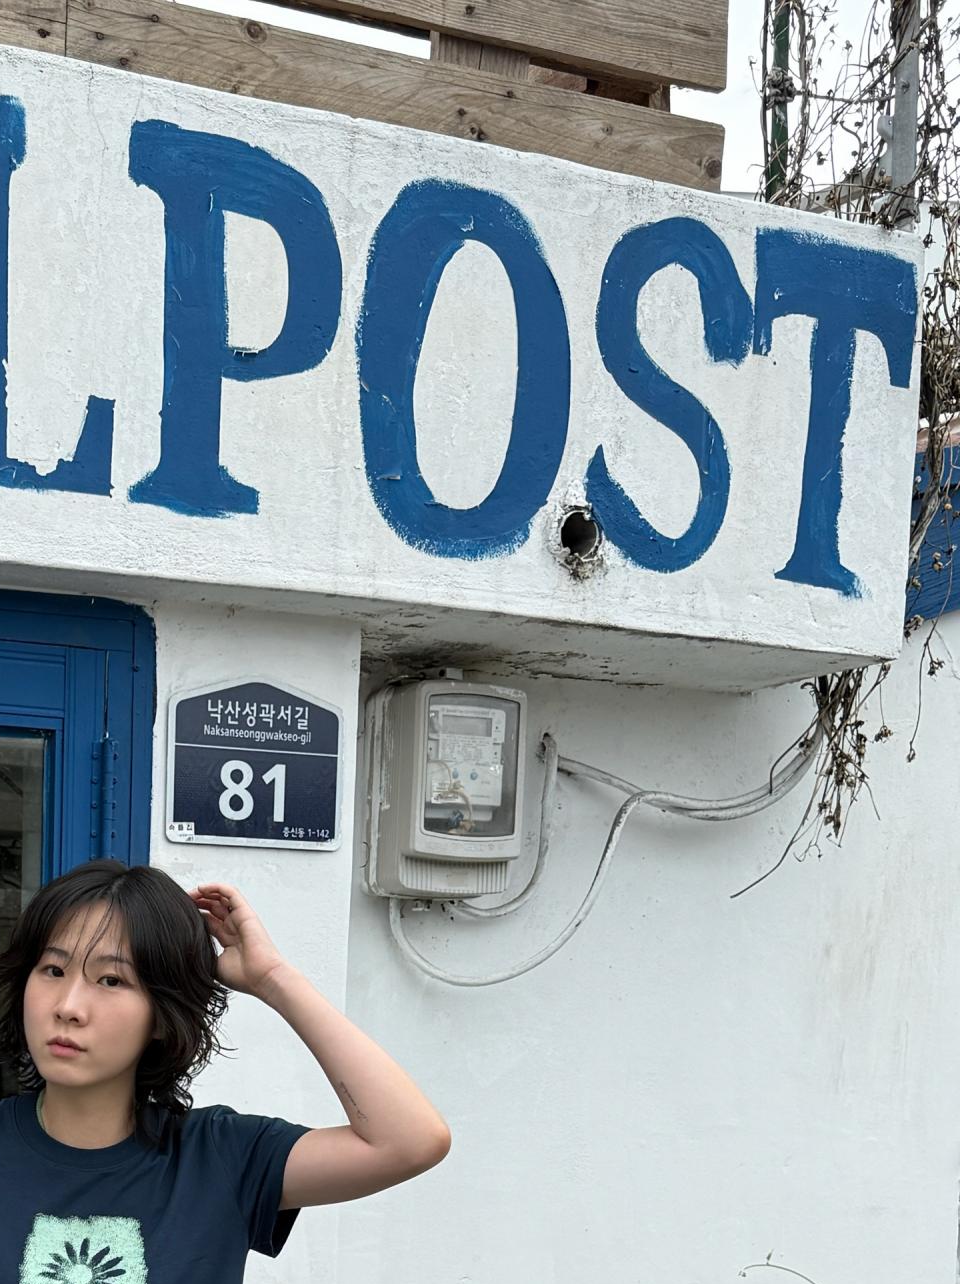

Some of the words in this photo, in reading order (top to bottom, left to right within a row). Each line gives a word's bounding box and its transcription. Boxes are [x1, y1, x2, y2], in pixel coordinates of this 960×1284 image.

[207, 700, 309, 730] 낙산성곽서길
[203, 725, 312, 745] Naksanseonggwakseo-gil
[218, 760, 286, 823] 81
[308, 828, 330, 838] 1-142
